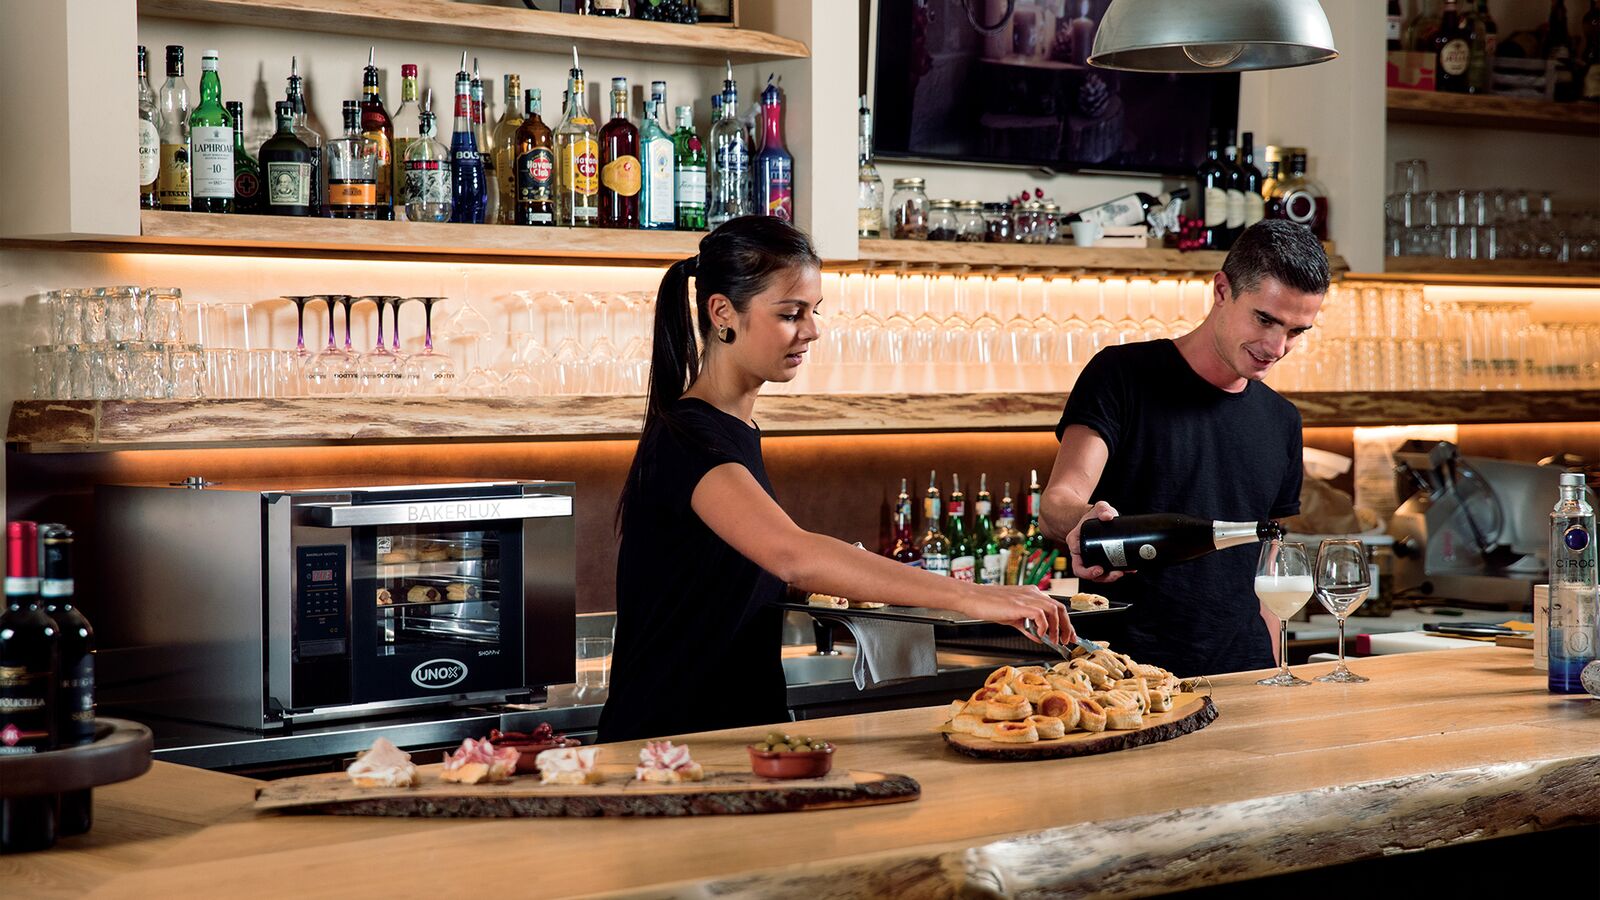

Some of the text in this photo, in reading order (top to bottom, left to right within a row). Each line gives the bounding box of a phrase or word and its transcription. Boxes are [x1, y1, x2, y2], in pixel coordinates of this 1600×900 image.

[456, 151, 480, 159] BOLS
[212, 164, 222, 173] 10
[407, 502, 501, 521] BAKERLUX
